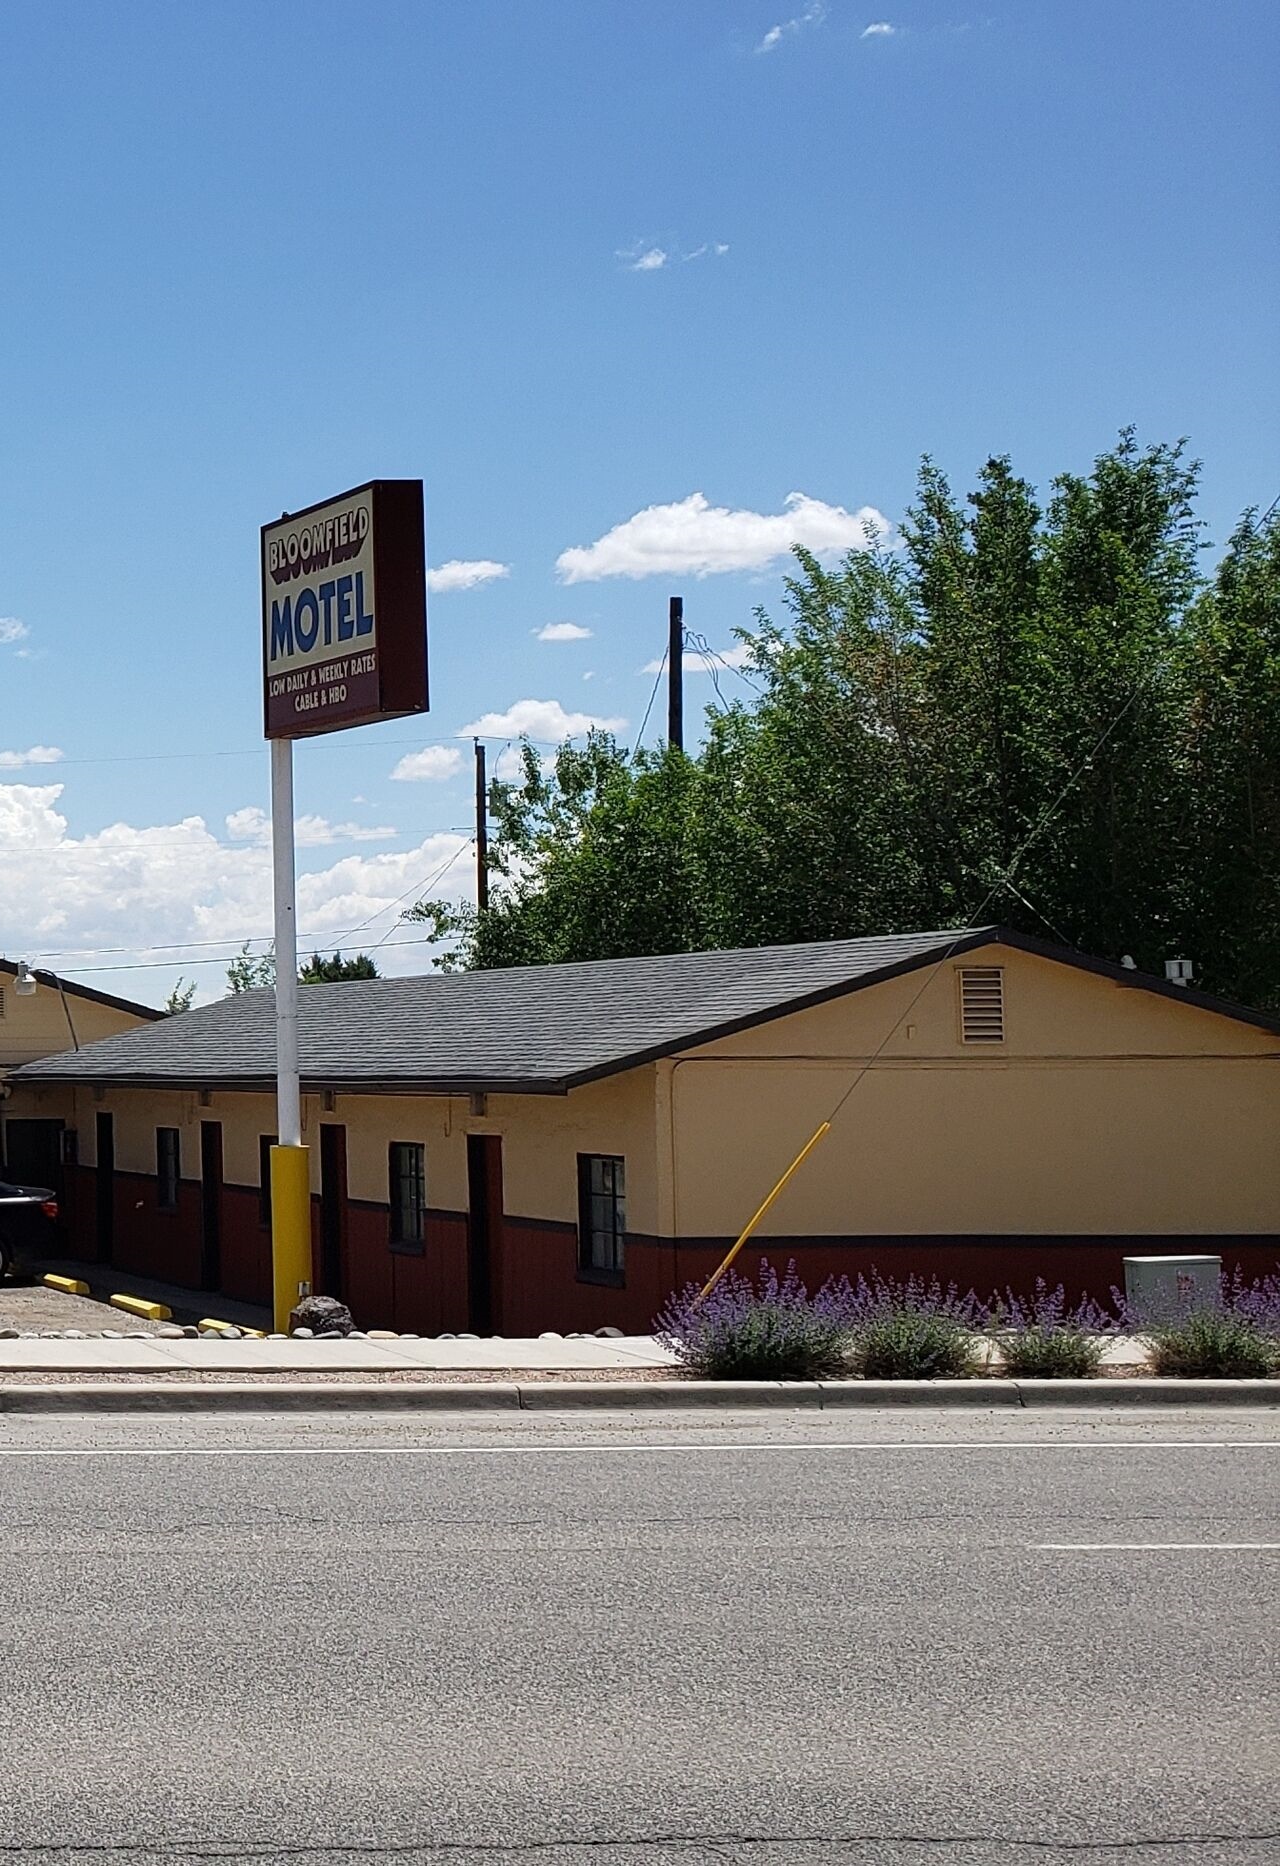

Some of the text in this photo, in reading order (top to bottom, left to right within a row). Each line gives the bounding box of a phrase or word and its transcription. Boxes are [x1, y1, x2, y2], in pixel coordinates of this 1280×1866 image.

[269, 506, 370, 580] BLOOMFIELD
[270, 571, 373, 661] MOTEL
[269, 653, 376, 697] LOW DAILY & WEEKLY RATES
[294, 685, 347, 712] CABLE & HBO
